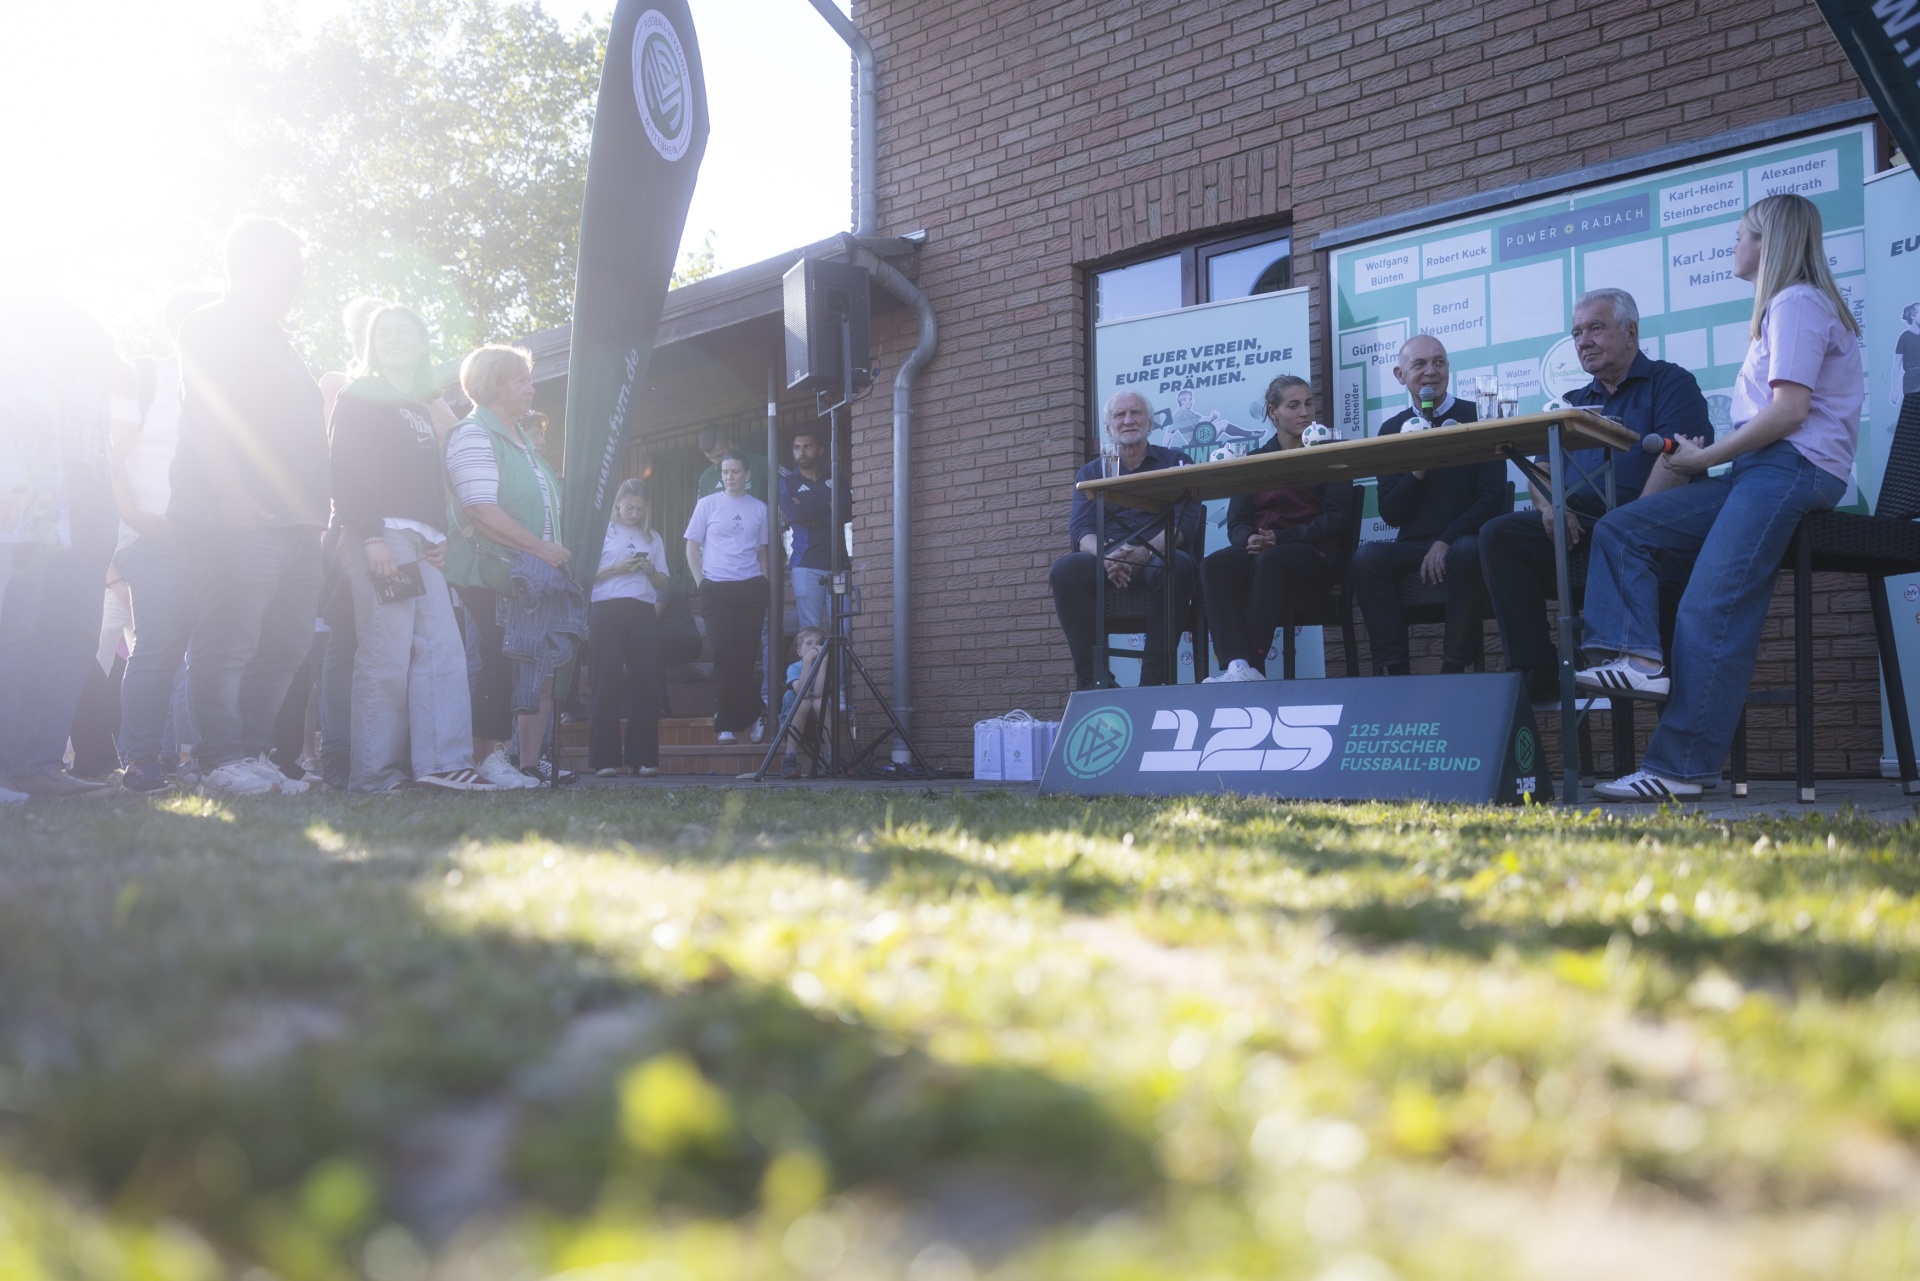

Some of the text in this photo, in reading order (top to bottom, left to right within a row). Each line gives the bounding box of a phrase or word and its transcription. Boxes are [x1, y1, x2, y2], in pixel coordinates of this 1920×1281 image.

[1760, 159, 1827, 182] Alexander
[1669, 180, 1734, 202] Karl-Heinz
[1766, 178, 1822, 197] Wildrath
[1663, 196, 1741, 221] Steinbrecher
[1506, 208, 1644, 248] POWER RADACH
[1366, 255, 1409, 271] Wolfgang
[1426, 246, 1487, 267] Robert Kuck
[1673, 250, 1705, 268] Karl
[1371, 272, 1404, 286] Bünten
[1689, 270, 1733, 287] Mainz
[1432, 298, 1470, 315] Bernd
[1420, 316, 1484, 336] Neuendorf
[1142, 337, 1262, 367] EUER VEREIN,
[1352, 340, 1398, 357] Günther
[1115, 347, 1293, 386] EURE PUNKTE, EURE
[1505, 369, 1531, 379] Walter
[1159, 371, 1246, 394] PRÄMIEN.
[1343, 393, 1351, 425] Benno
[1351, 383, 1360, 432] Schneider
[594, 347, 639, 511] www.fvm.de
[1138, 704, 1344, 772] 125
[1348, 722, 1441, 738] 125 JAHRE
[1344, 739, 1448, 754] DEUTSCHER
[1339, 757, 1481, 772] FUSSBALL-BUND
[1516, 776, 1536, 795] 125
